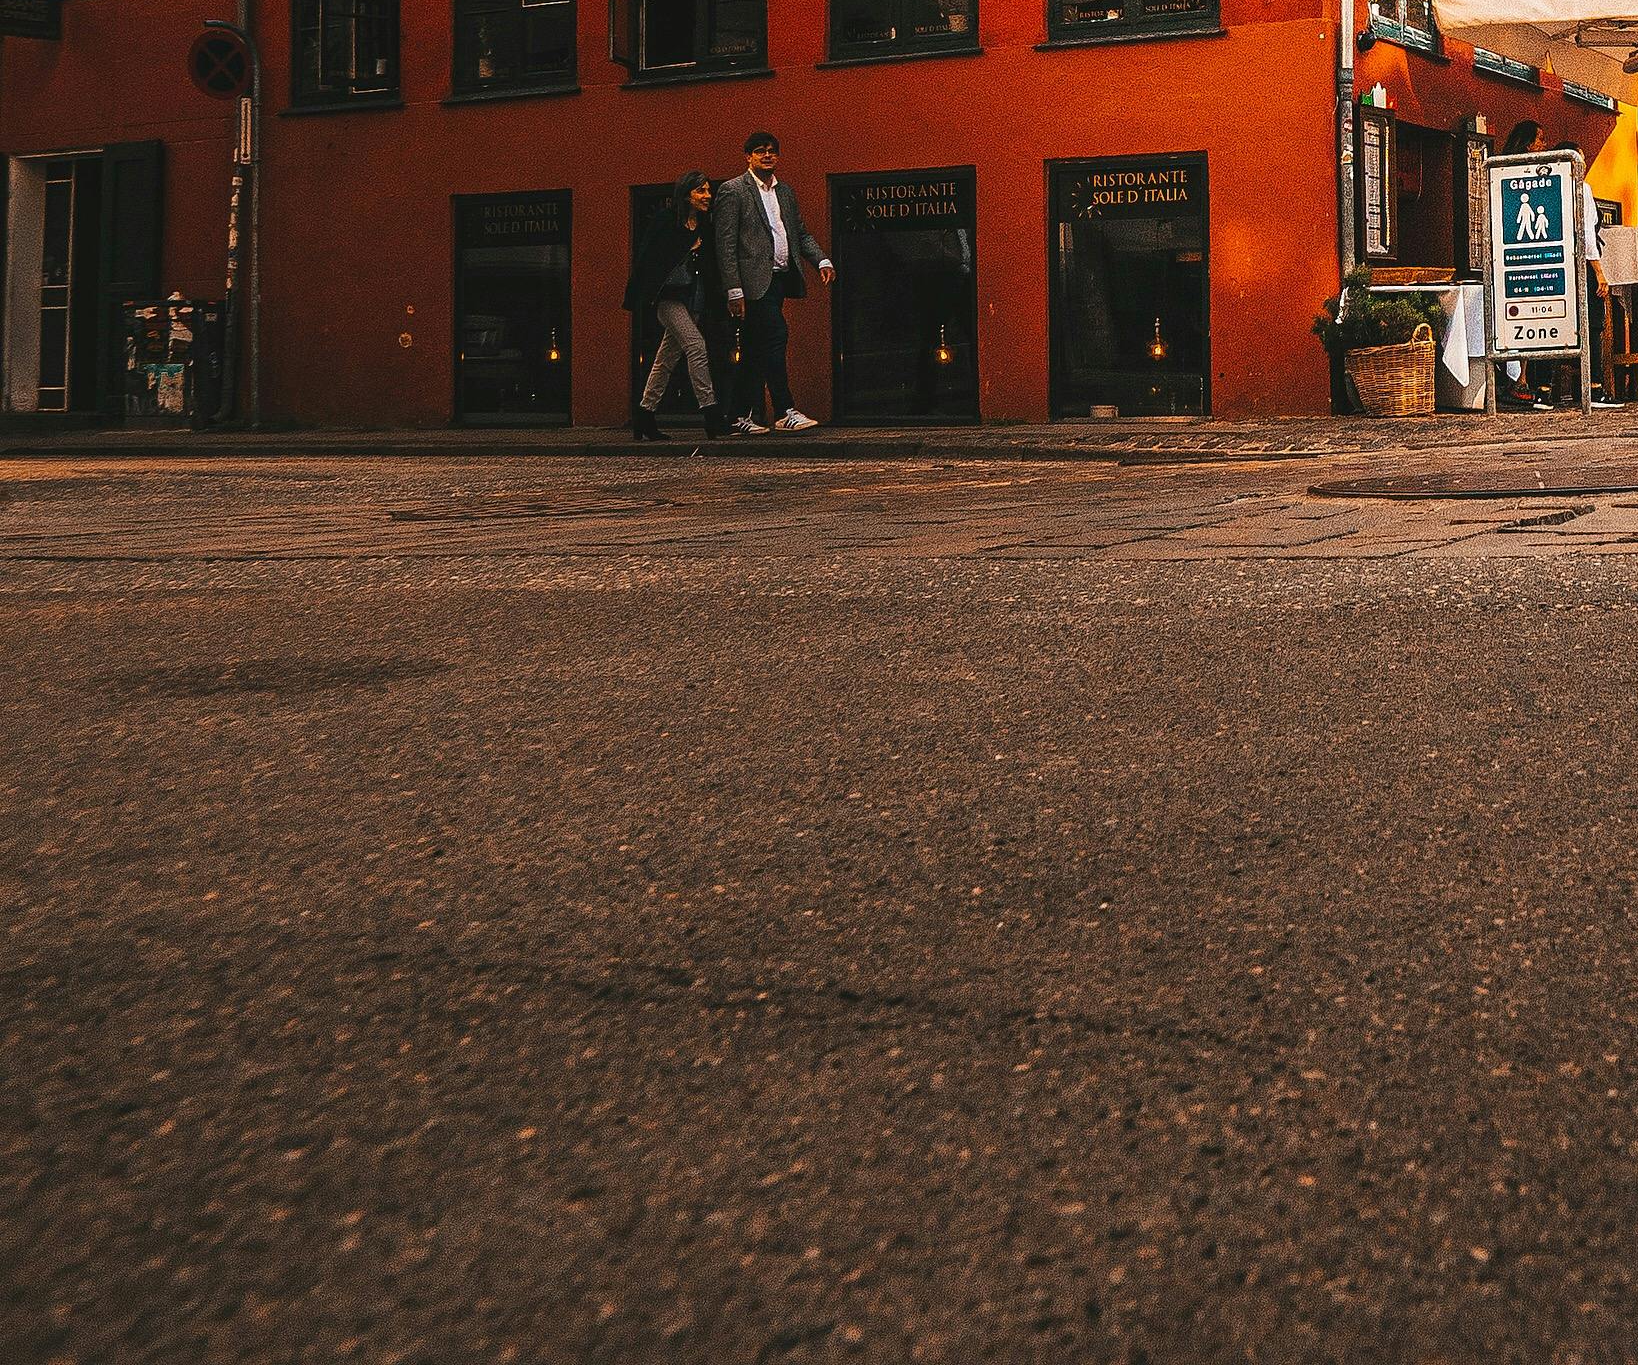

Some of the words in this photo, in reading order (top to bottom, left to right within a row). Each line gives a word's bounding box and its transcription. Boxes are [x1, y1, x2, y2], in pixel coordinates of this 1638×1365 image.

[1093, 170, 1188, 188] RISTORANTE
[1509, 177, 1552, 191] Gågade
[866, 182, 956, 200] RISTORANTE
[1093, 190, 1124, 205] SOLE
[484, 202, 559, 218] RISTORANTE
[866, 203, 896, 219] SOLE
[484, 222, 510, 236] SOLE
[1513, 325, 1559, 341] Zone
